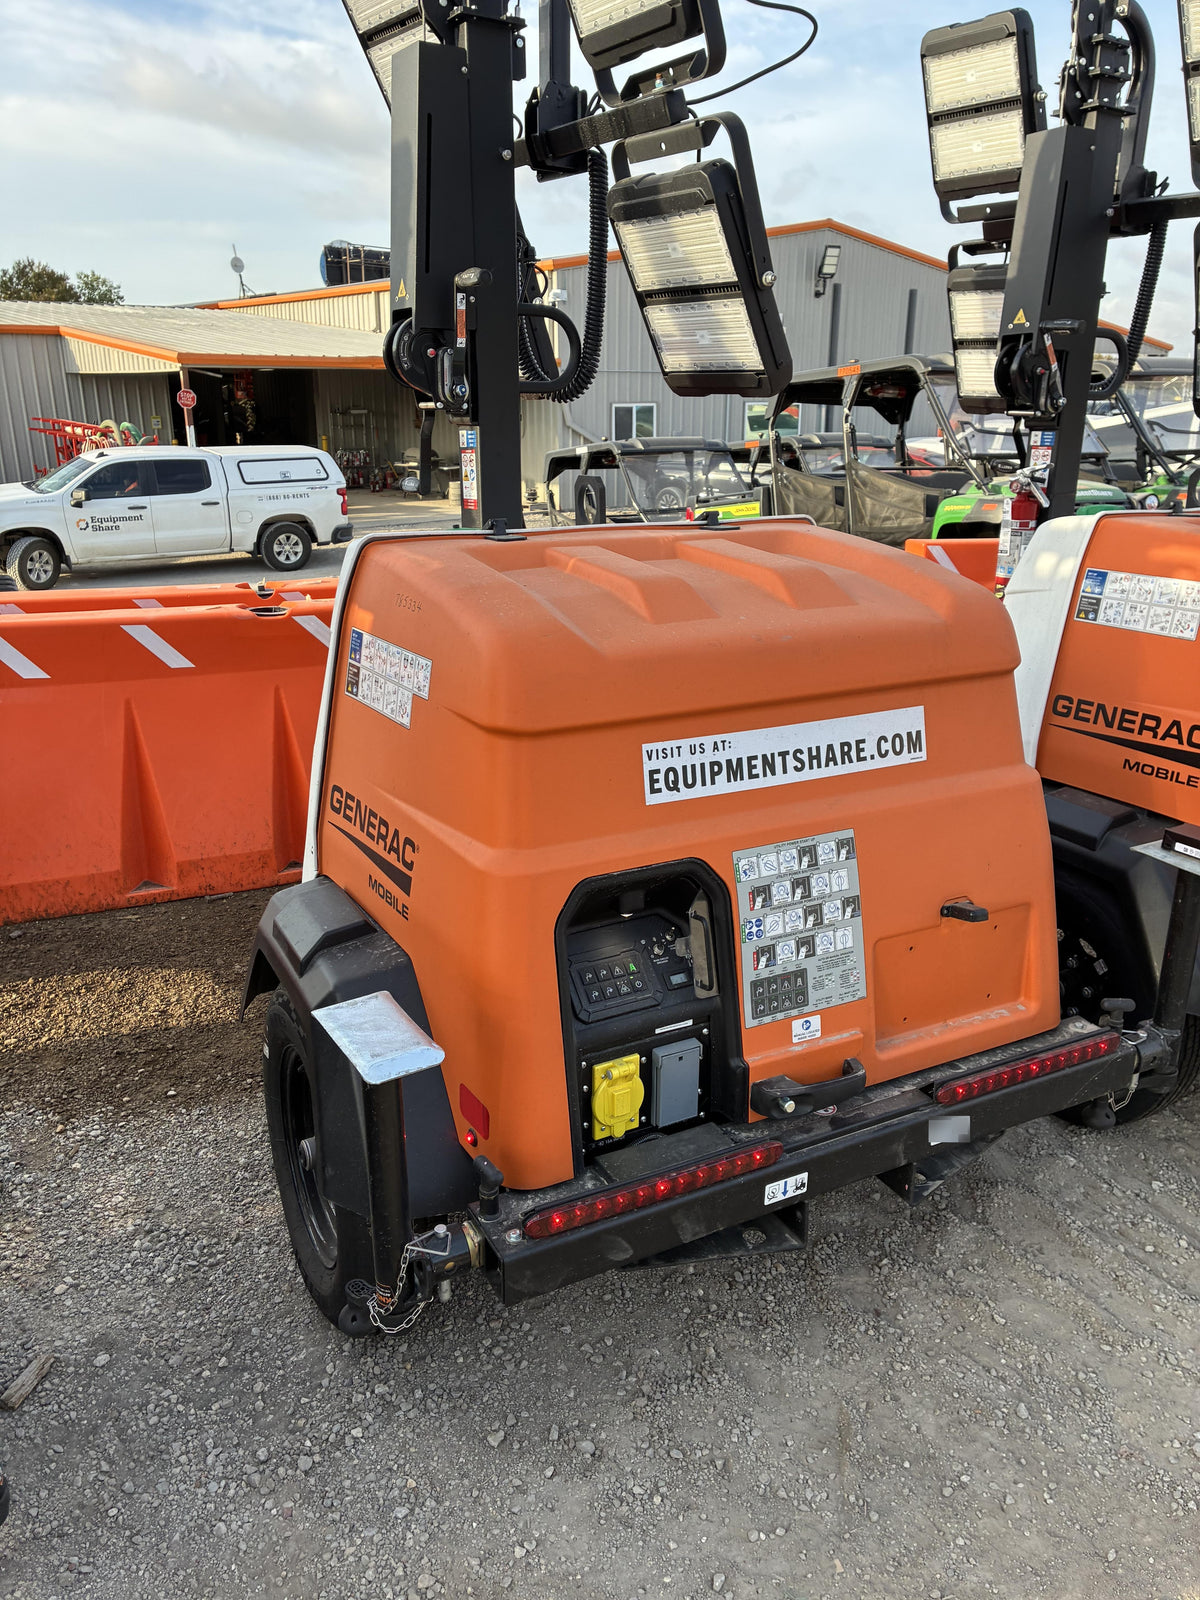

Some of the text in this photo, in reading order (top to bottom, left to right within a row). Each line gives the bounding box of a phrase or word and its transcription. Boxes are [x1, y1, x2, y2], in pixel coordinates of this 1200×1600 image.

[90, 513, 144, 525] Equipment
[91, 524, 120, 532] Share
[1051, 694, 1200, 750] GENERAC
[646, 740, 732, 761] VISIT US AT:
[648, 730, 923, 794] EQUIPMENTSHARE.COM
[1122, 758, 1200, 789] MOBILE
[329, 784, 416, 872] GENERAC
[368, 873, 410, 921] MOBILE
